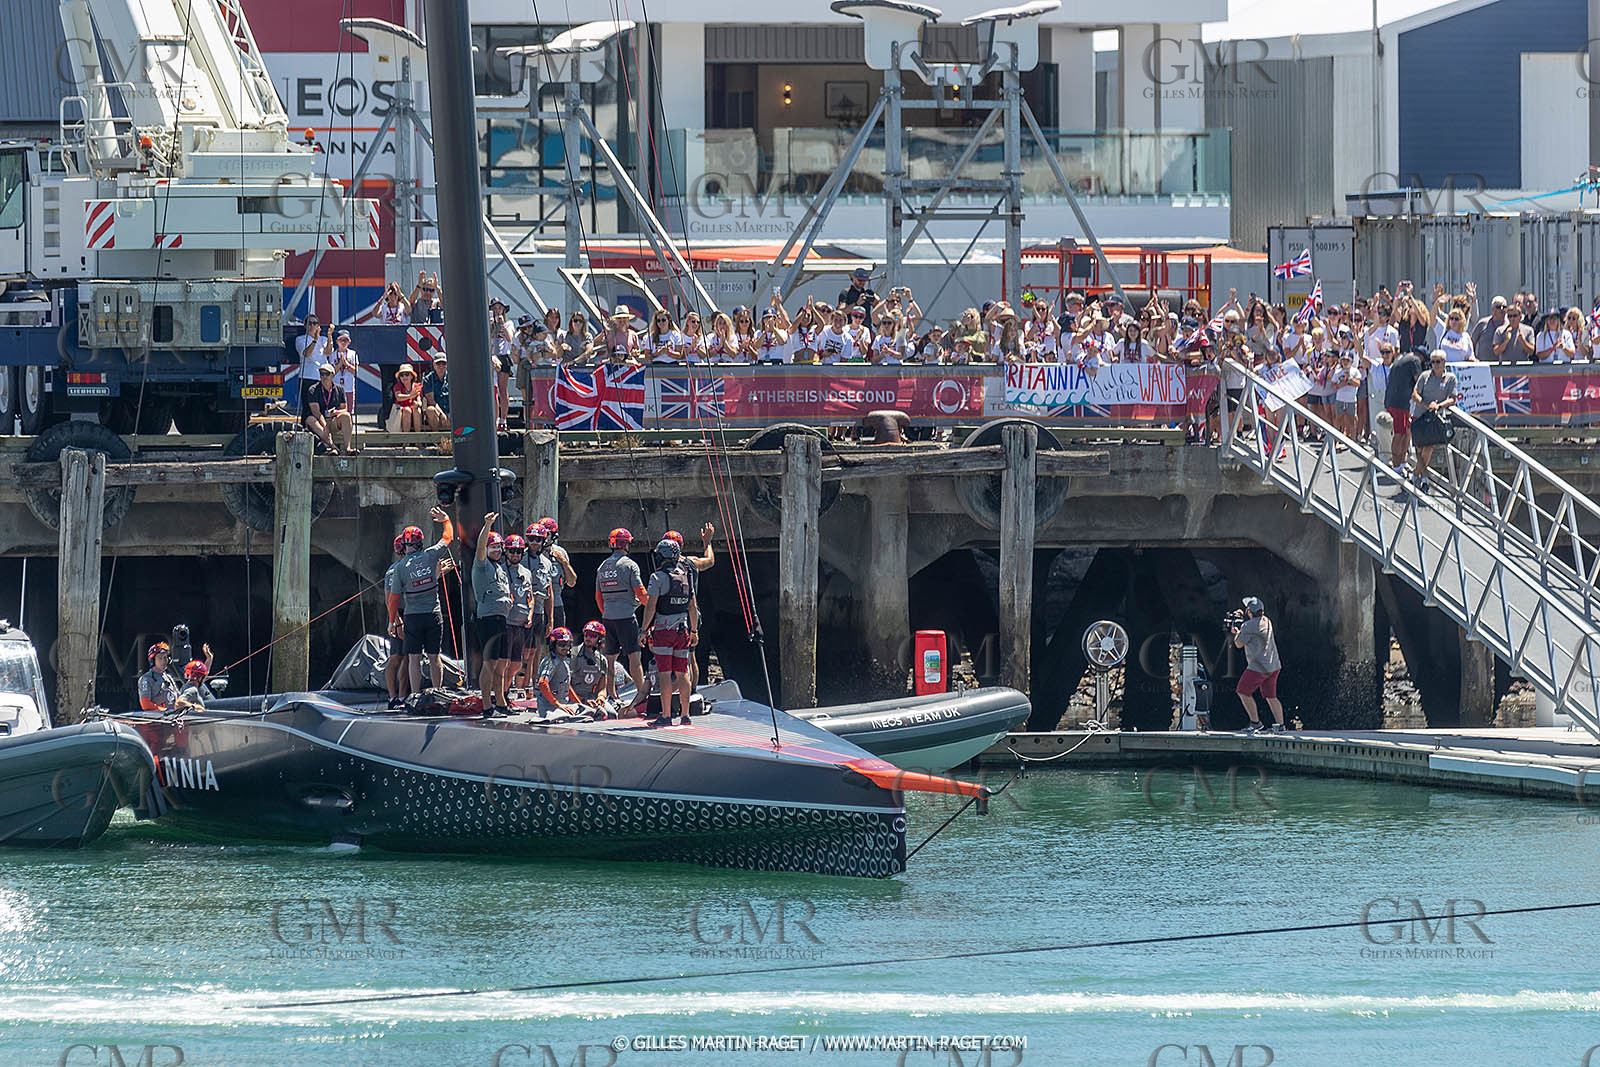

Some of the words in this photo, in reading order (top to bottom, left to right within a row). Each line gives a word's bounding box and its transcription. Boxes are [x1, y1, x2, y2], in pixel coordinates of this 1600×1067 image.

[1262, 365, 1288, 383] ULE
[1137, 364, 1187, 402] WAVES
[748, 389, 896, 403] #THEREISNOSECOND
[1570, 388, 1600, 400] BR
[410, 567, 431, 578] INEOS
[871, 719, 903, 729] INEOS
[907, 712, 942, 724] TEAM
[942, 707, 961, 719] UK
